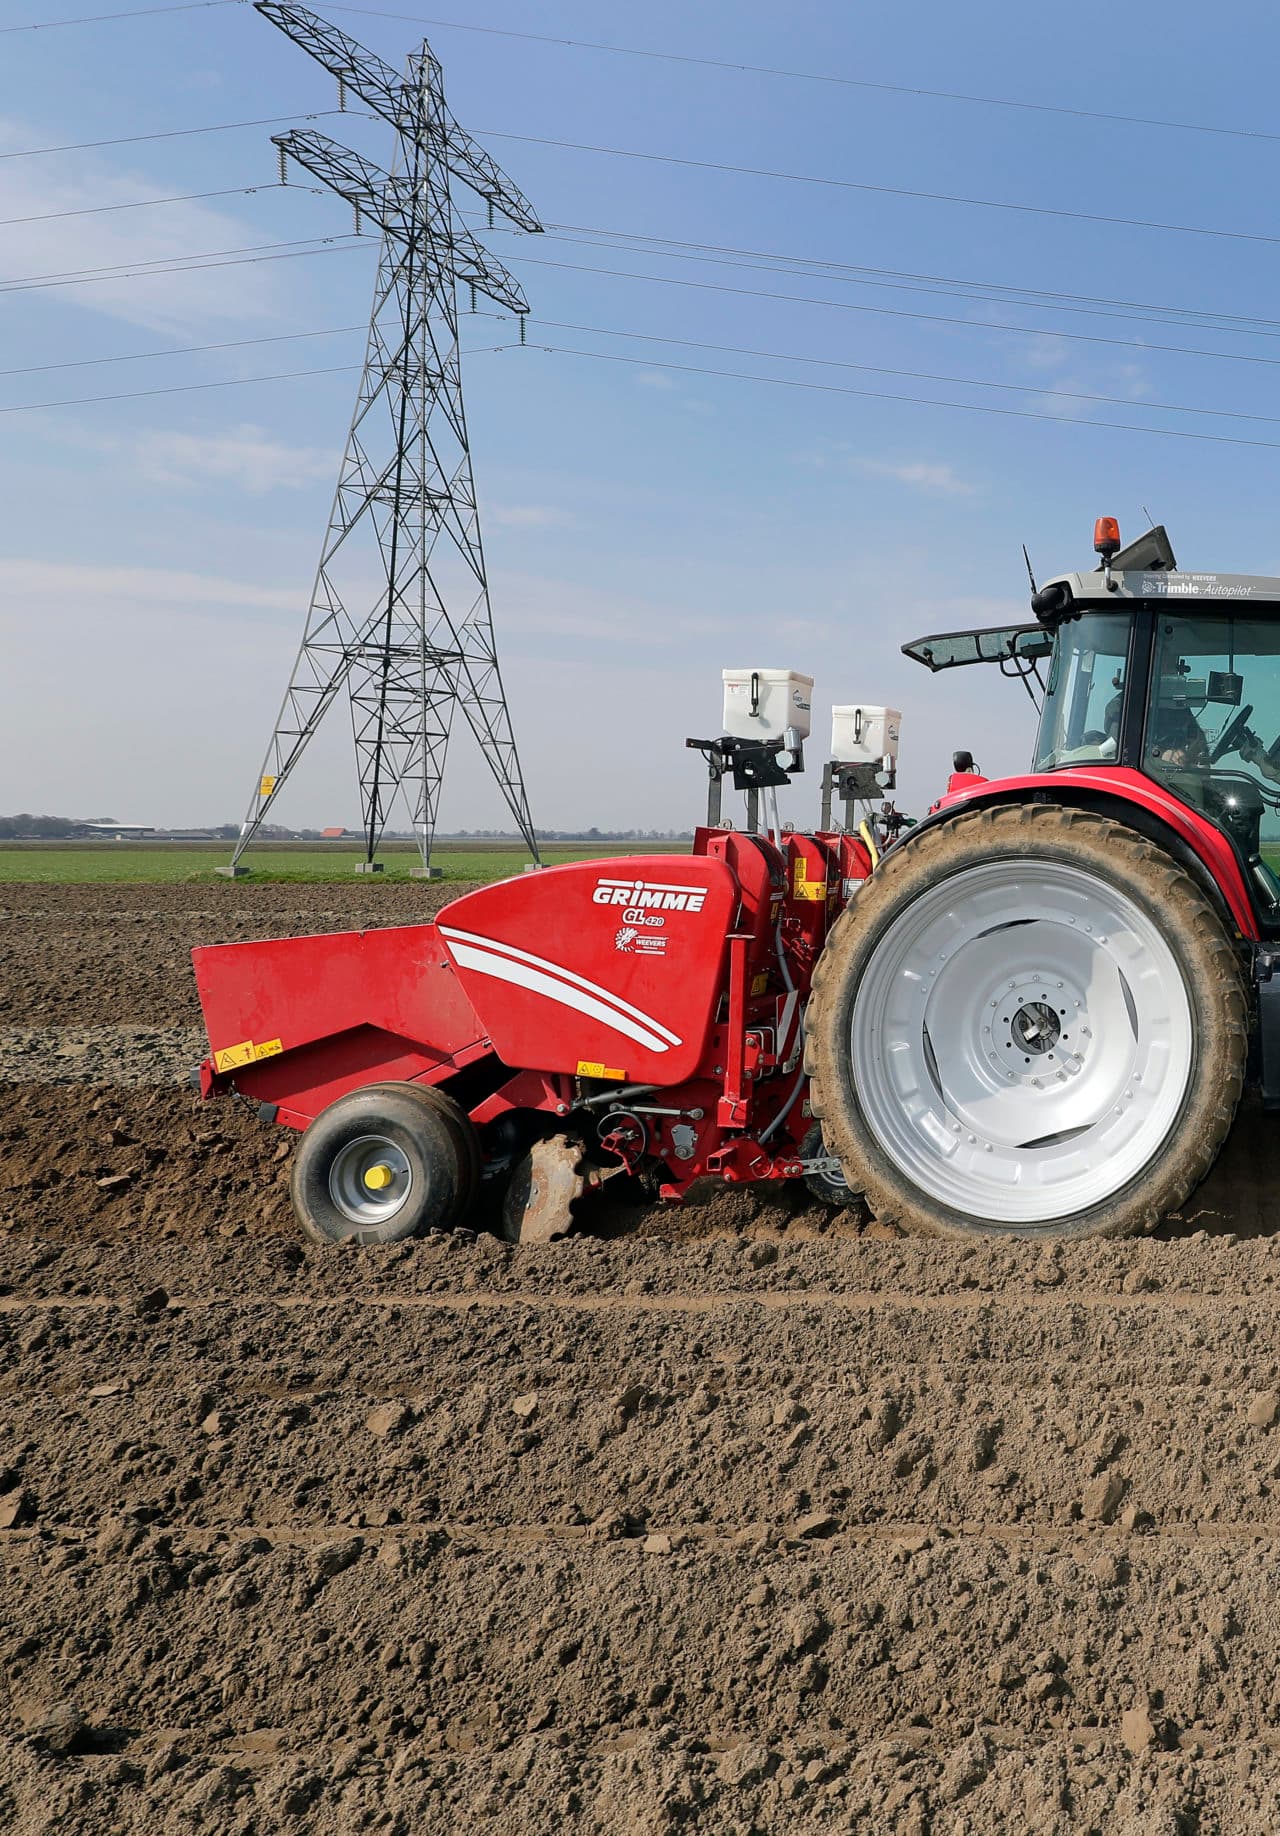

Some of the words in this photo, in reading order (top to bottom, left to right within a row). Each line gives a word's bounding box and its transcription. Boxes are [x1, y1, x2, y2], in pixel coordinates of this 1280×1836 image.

[1157, 581, 1200, 594] Trimble
[1203, 584, 1251, 597] Autopilot
[593, 880, 706, 912] GRIMME
[623, 908, 645, 924] GL
[645, 917, 664, 926] 420
[636, 939, 666, 947] WEEVERS
